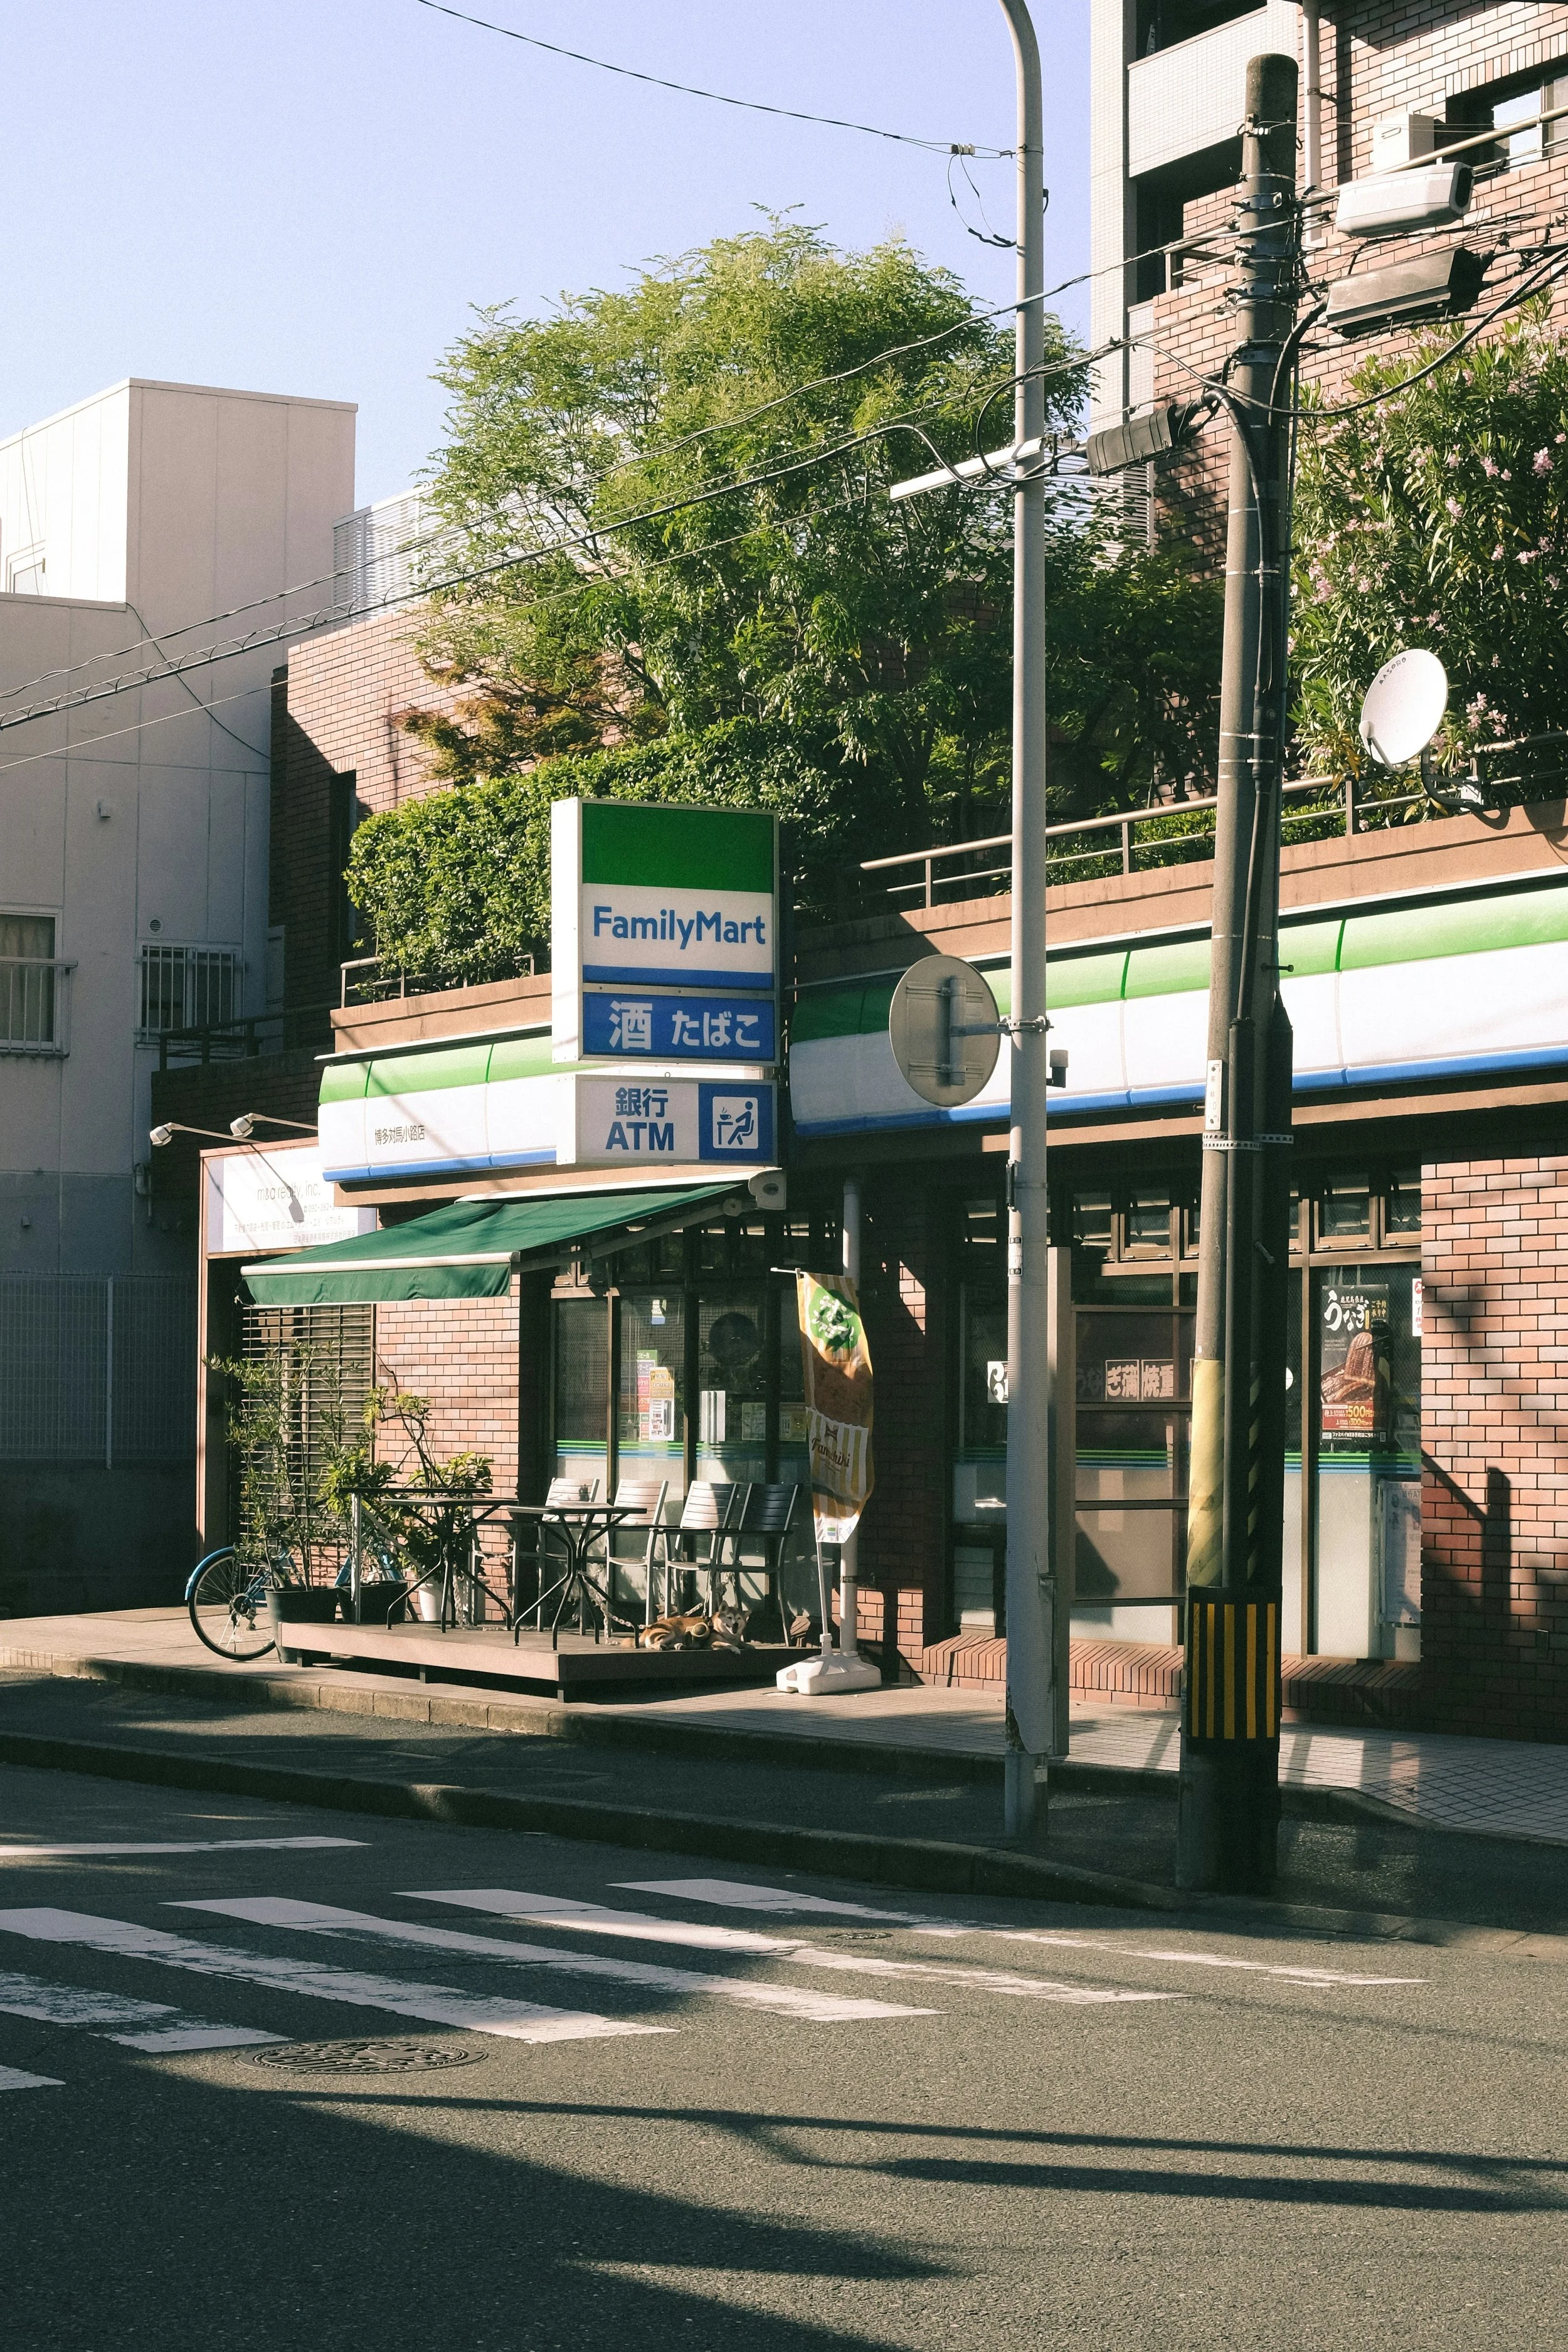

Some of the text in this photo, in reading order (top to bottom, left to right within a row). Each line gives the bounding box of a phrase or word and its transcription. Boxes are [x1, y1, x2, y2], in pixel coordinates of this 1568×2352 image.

[593, 905, 766, 950] FamilyMart
[608, 1000, 761, 1051] 酒 たばこ
[615, 1086, 669, 1119] 銀行
[374, 1123, 425, 1145] 博多対馬小路店
[605, 1121, 675, 1152] ATM
[305, 1177, 321, 1197] inc.
[1323, 1290, 1370, 1332] うなぎ
